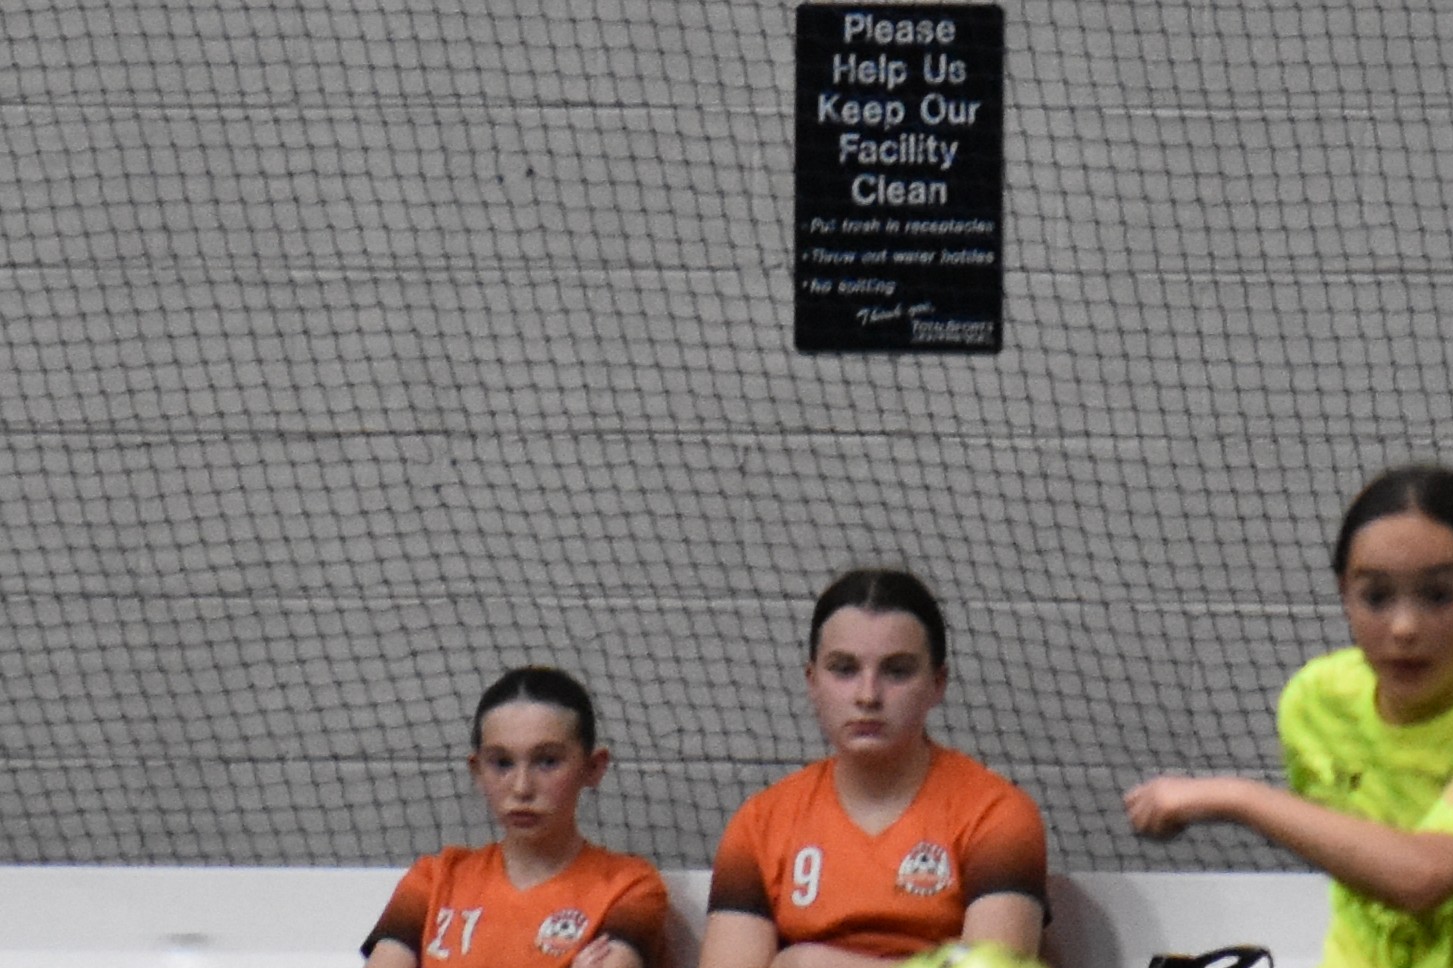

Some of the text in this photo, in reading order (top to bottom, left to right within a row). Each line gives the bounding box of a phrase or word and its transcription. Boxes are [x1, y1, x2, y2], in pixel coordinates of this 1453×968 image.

[843, 12, 956, 44] Please
[832, 53, 967, 91] Help Us
[817, 92, 981, 130] Keep Our
[838, 132, 959, 171] Facility
[851, 174, 948, 206] Clean
[791, 846, 823, 907] 9
